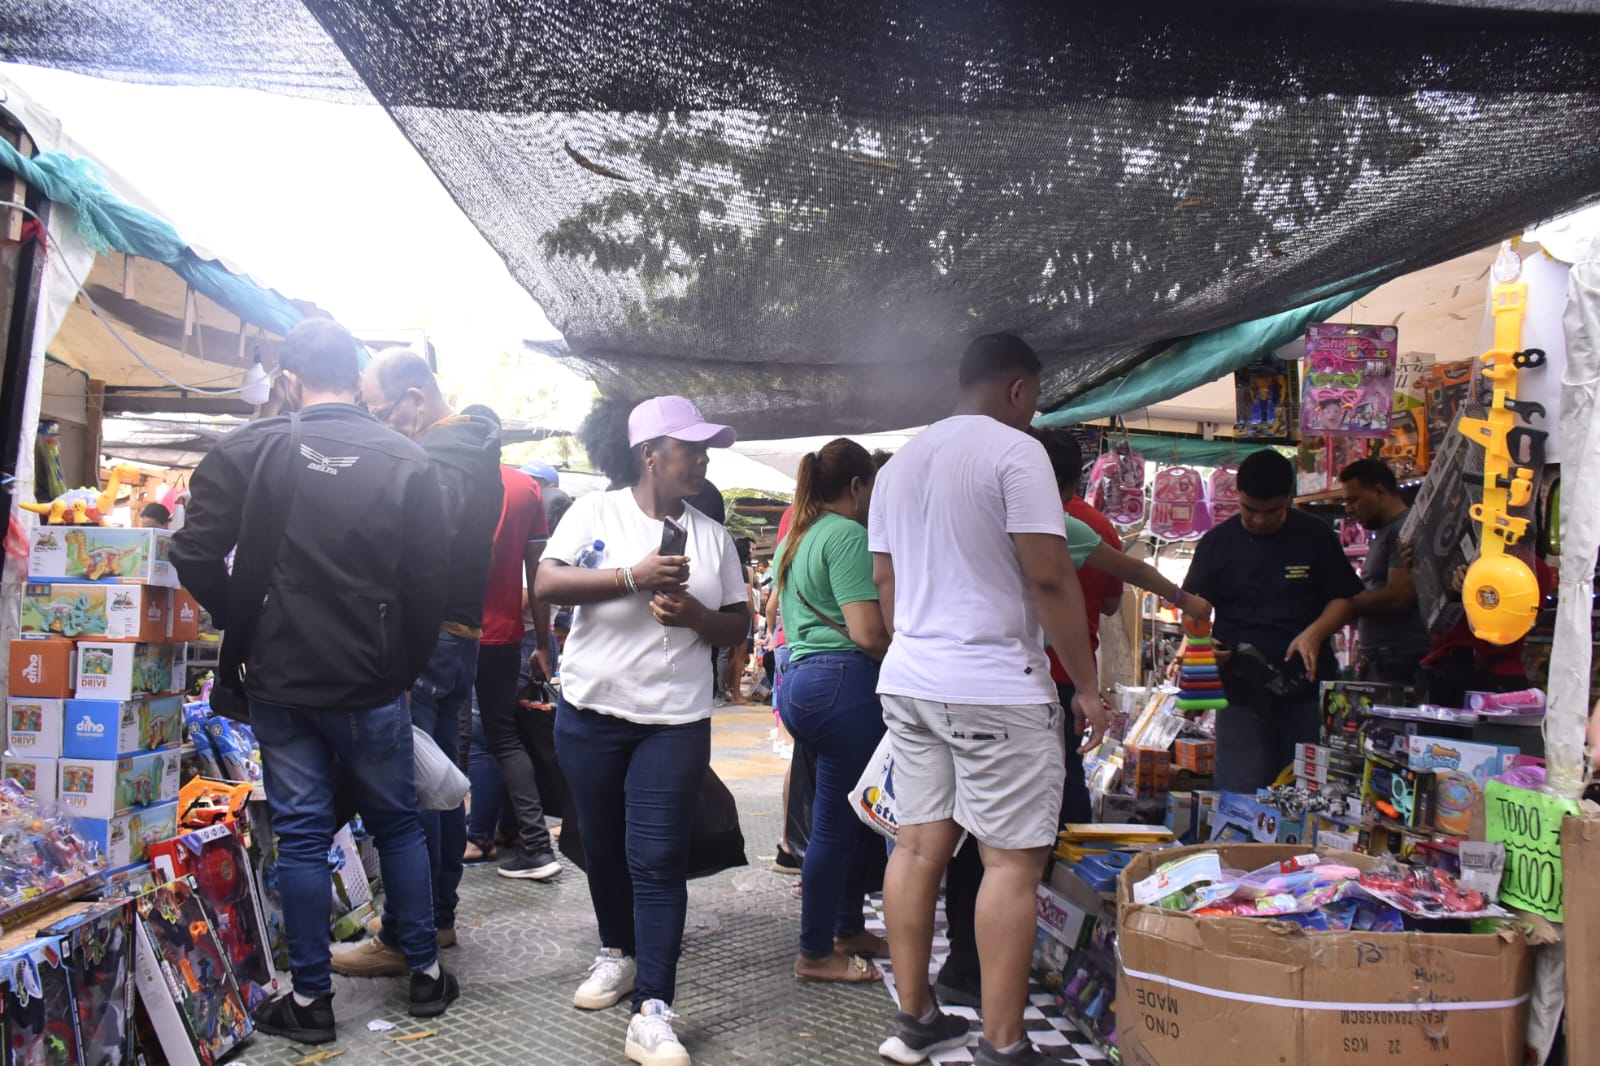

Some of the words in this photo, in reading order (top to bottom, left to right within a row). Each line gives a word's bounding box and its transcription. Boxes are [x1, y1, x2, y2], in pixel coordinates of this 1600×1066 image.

[307, 462, 338, 475] DELTA
[82, 679, 107, 688] DRIVE
[1496, 797, 1541, 841] TODO
[1136, 988, 1178, 1016] MADE
[1140, 1012, 1180, 1039] C/NO.
[1344, 1037, 1369, 1053] KGS
[1388, 1040, 1401, 1054] 22
